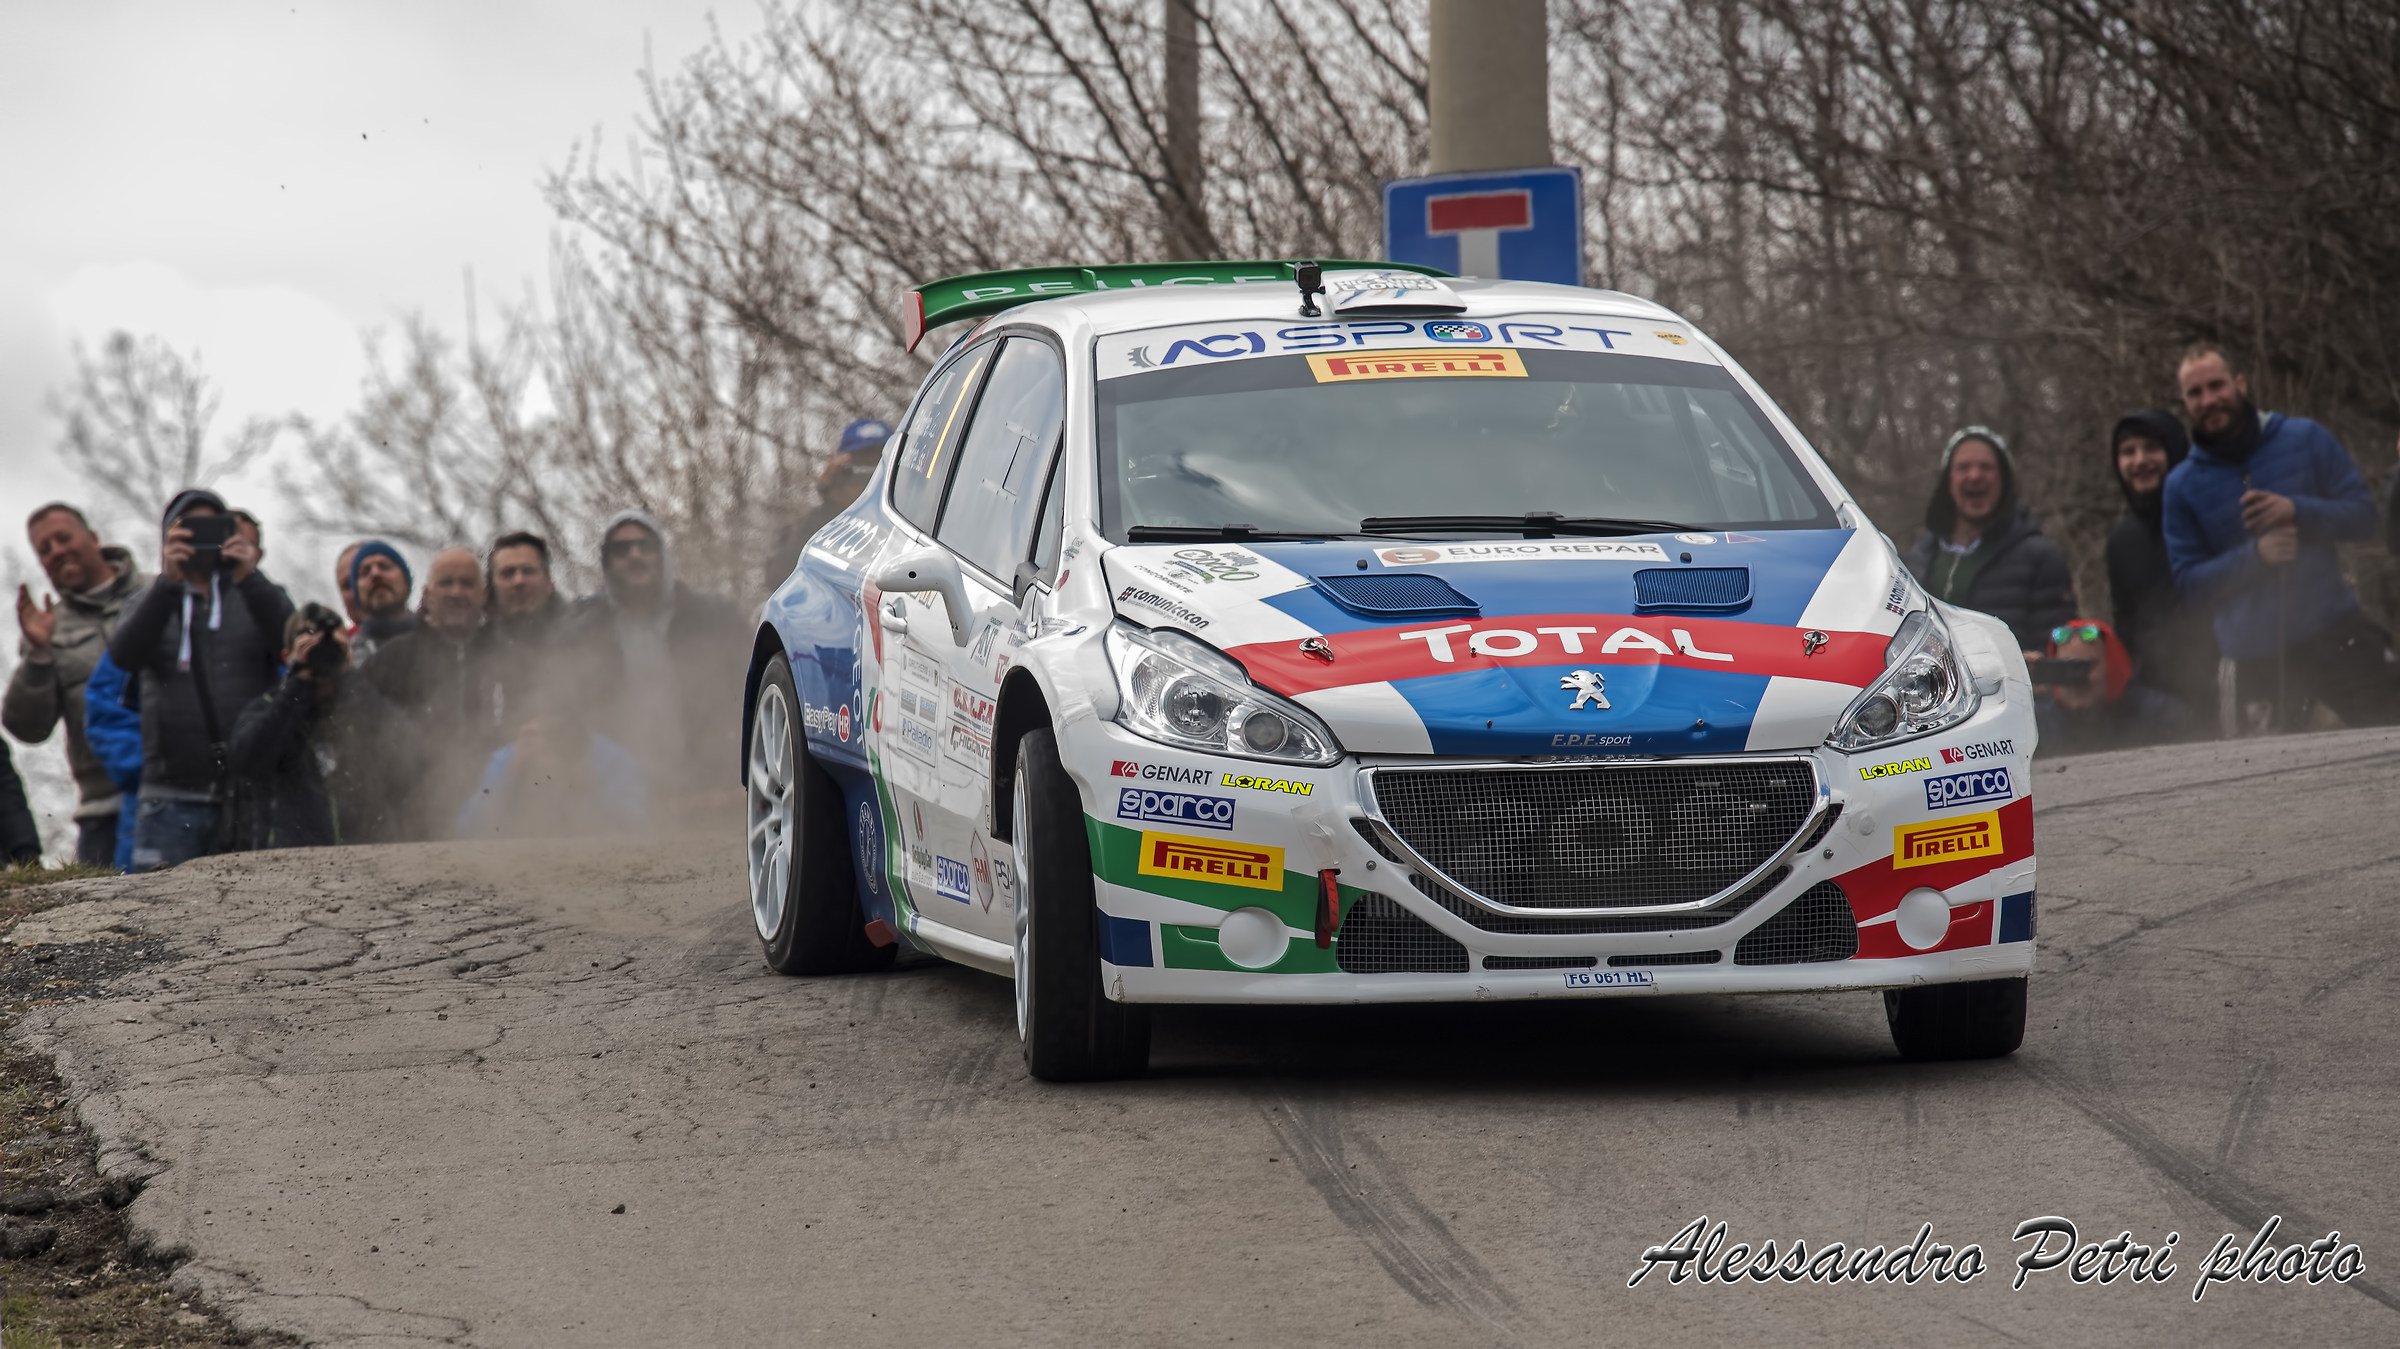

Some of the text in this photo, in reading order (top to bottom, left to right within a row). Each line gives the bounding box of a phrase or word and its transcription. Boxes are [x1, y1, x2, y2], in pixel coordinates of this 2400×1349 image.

[1325, 353, 1506, 376] PIRELLI
[1448, 545, 1660, 556] EURO REPAR
[1133, 590, 1210, 629] comunicacon
[1399, 624, 1735, 663] TOTAL
[1965, 739, 2014, 760] GENART
[1142, 764, 1213, 786] GENART
[1928, 770, 2010, 807] sparco
[1122, 789, 1233, 821] sparco
[1903, 821, 1990, 860] PIRELLI
[937, 858, 970, 894] sparco
[1153, 840, 1271, 881] PIRELLI
[1568, 972, 1648, 985] FG 061 HL
